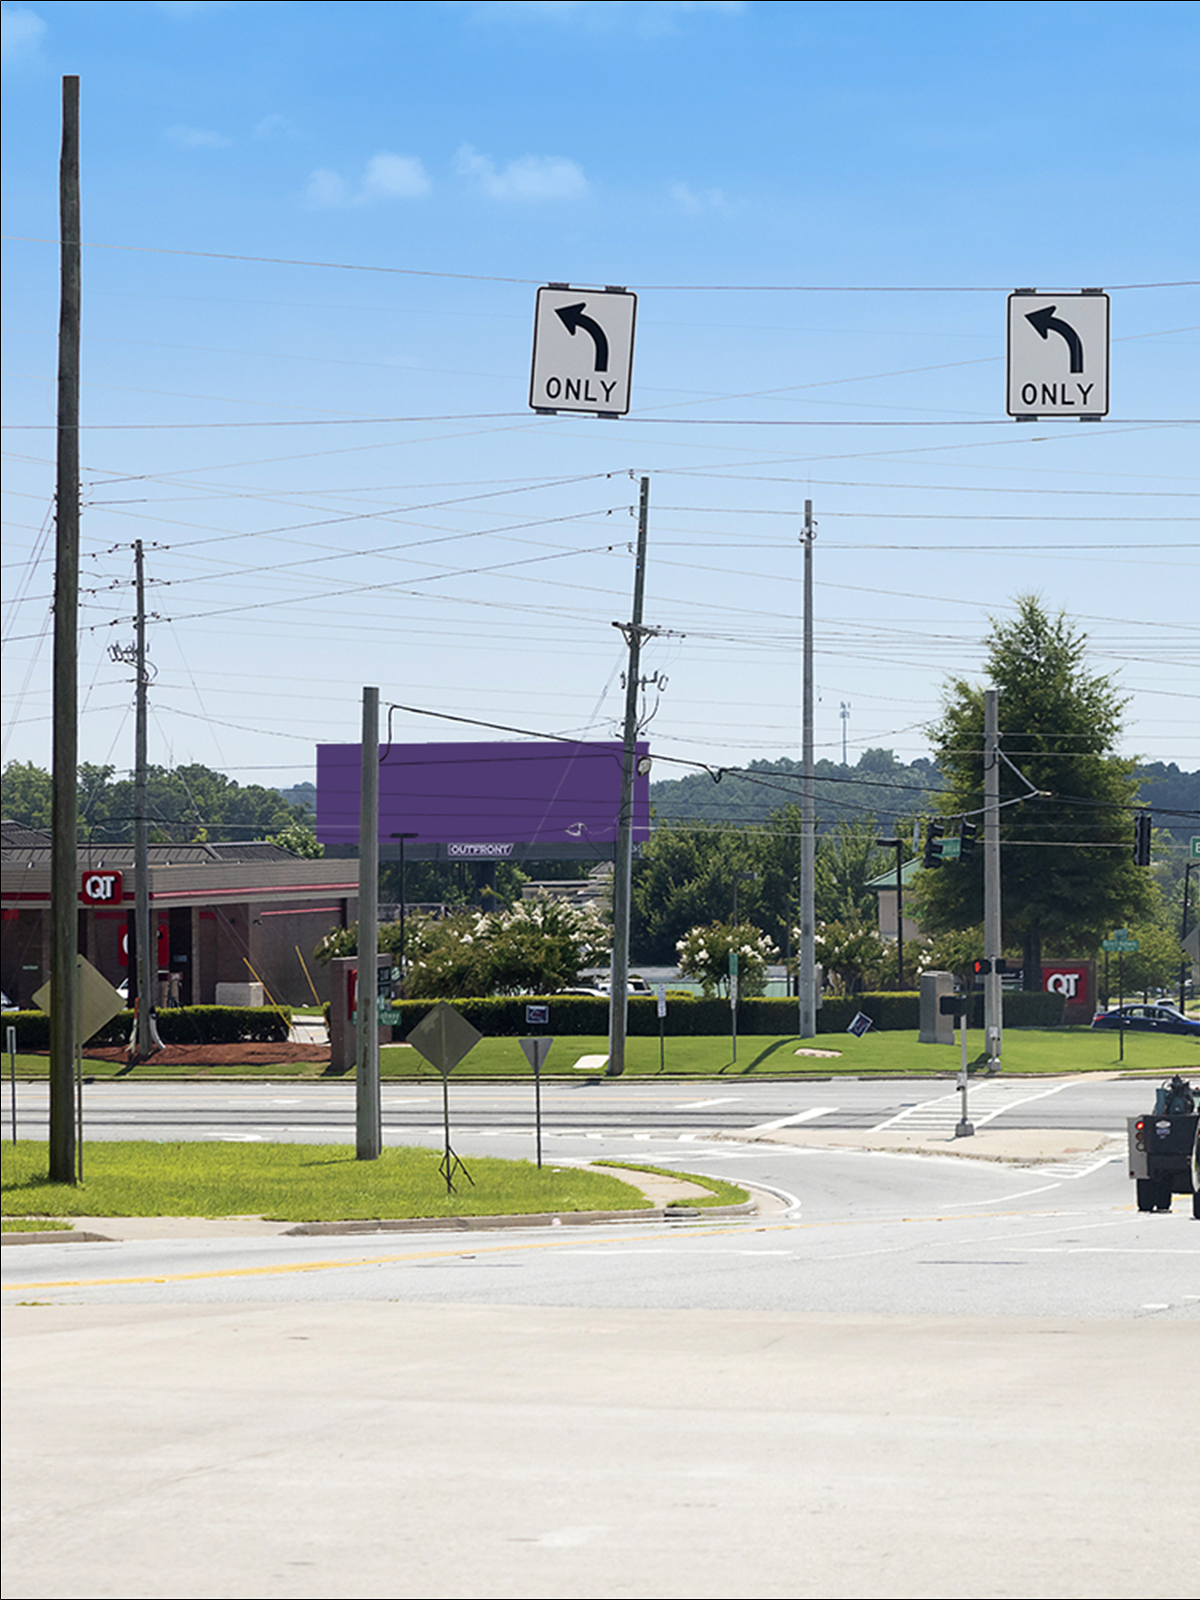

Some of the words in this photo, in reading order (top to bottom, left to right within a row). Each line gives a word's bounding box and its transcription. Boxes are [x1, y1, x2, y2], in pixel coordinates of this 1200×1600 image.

[545, 376, 618, 403] ONLY
[1021, 382, 1095, 406] ONLY
[449, 843, 511, 855] OUTFRONT
[85, 875, 117, 900] QT
[1047, 973, 1080, 998] QT
